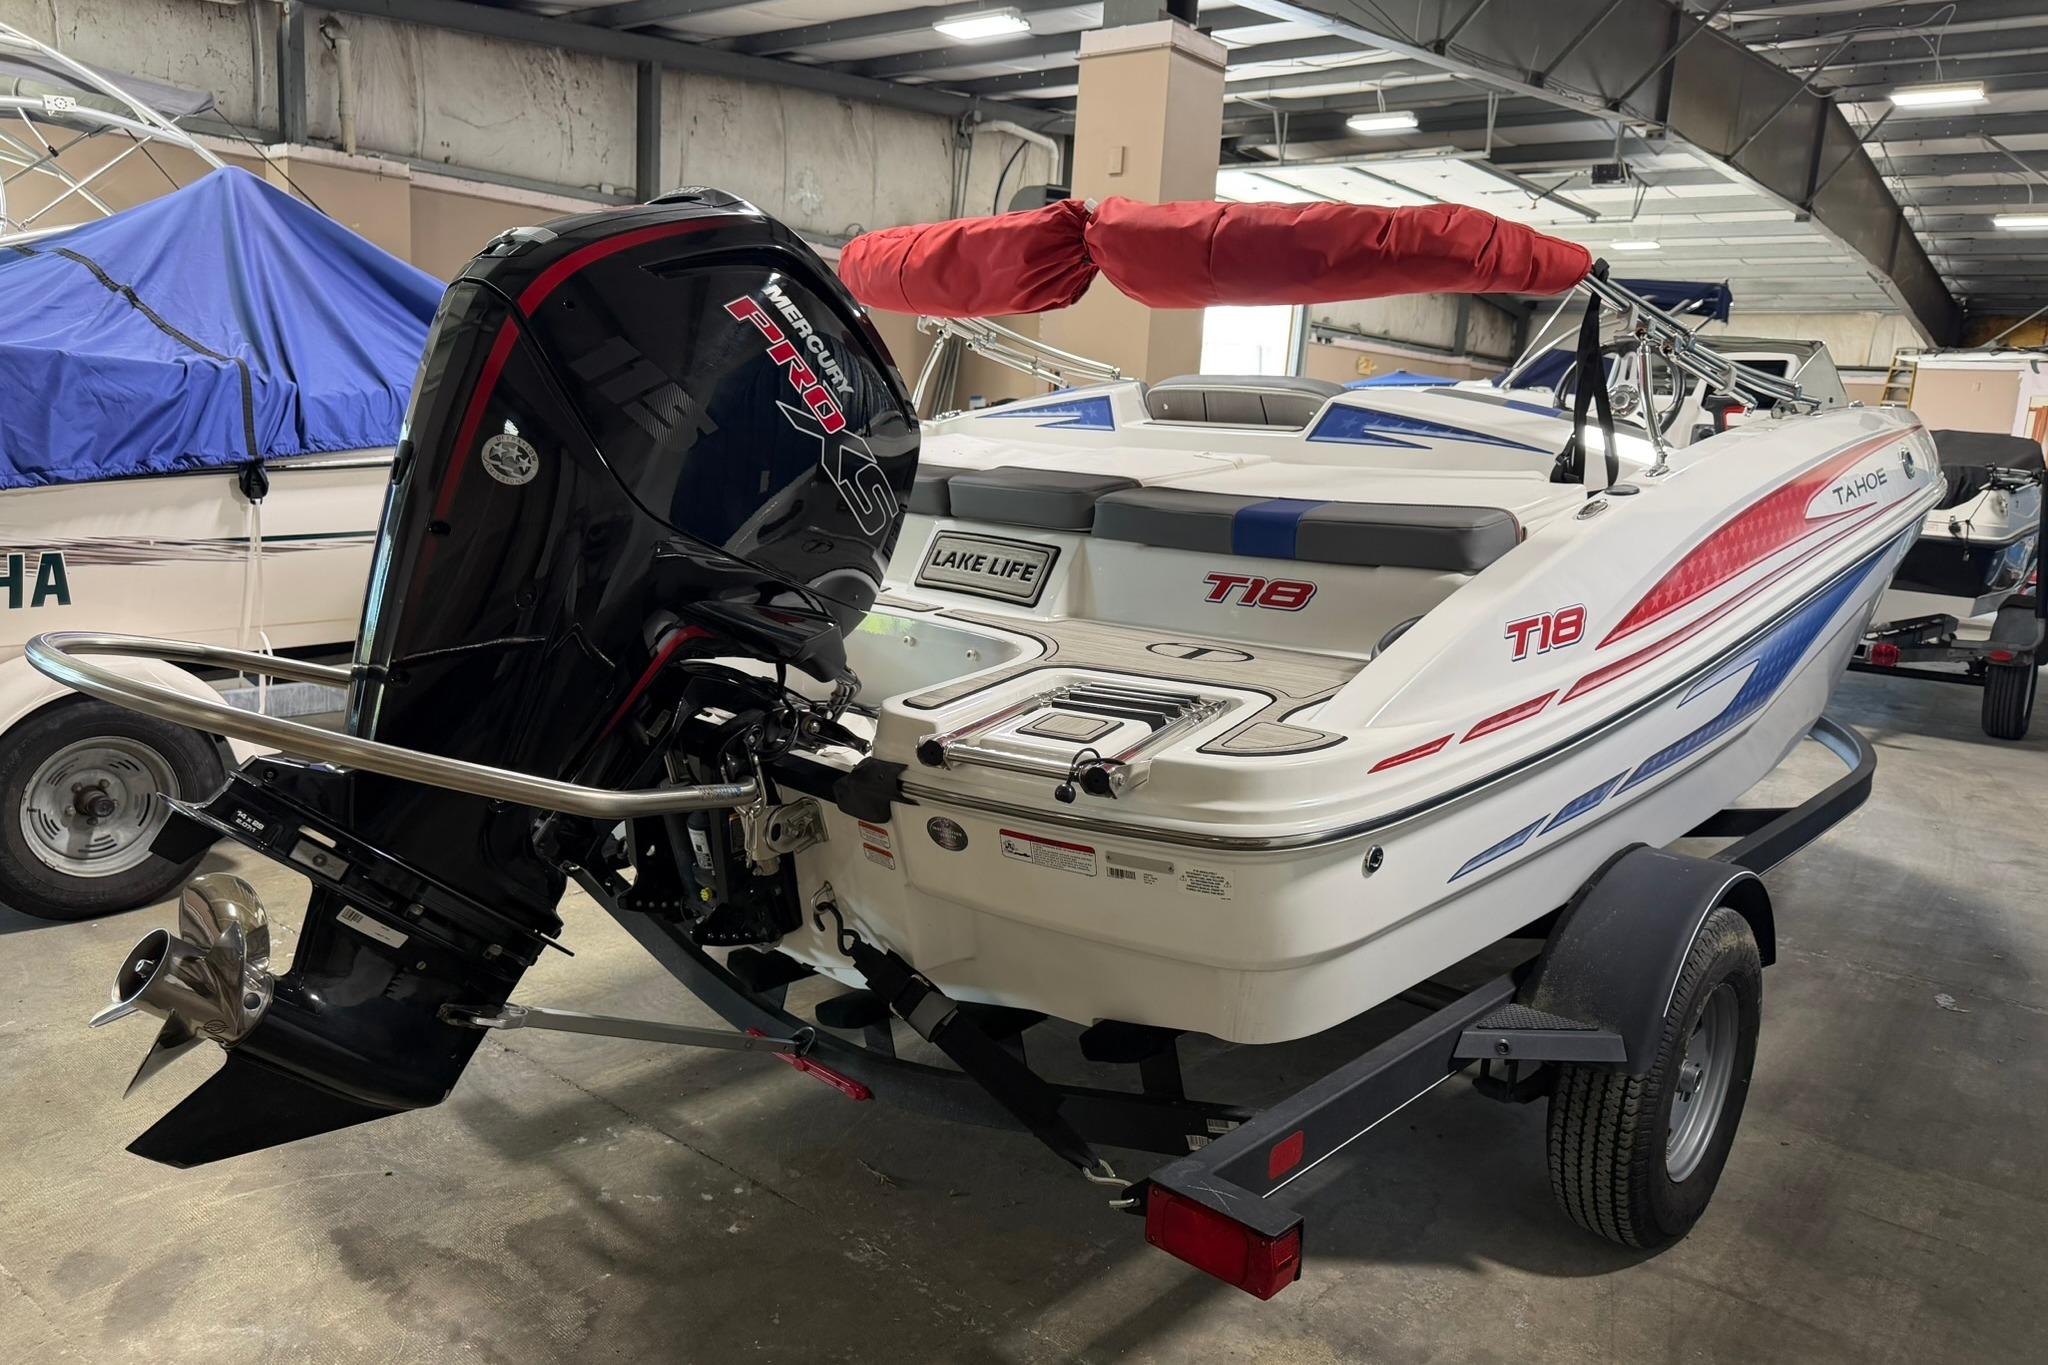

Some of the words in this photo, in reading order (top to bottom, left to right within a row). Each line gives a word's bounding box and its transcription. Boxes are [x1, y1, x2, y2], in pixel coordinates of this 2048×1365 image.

[724, 295, 846, 434] PRO
[762, 284, 854, 395] MERCURY
[776, 381, 899, 536] XS
[1832, 467, 1888, 505] TAHOE
[931, 550, 987, 572] LAKE
[988, 558, 1038, 582] LIFE
[1203, 571, 1318, 611] T18
[1504, 603, 1587, 662] T18
